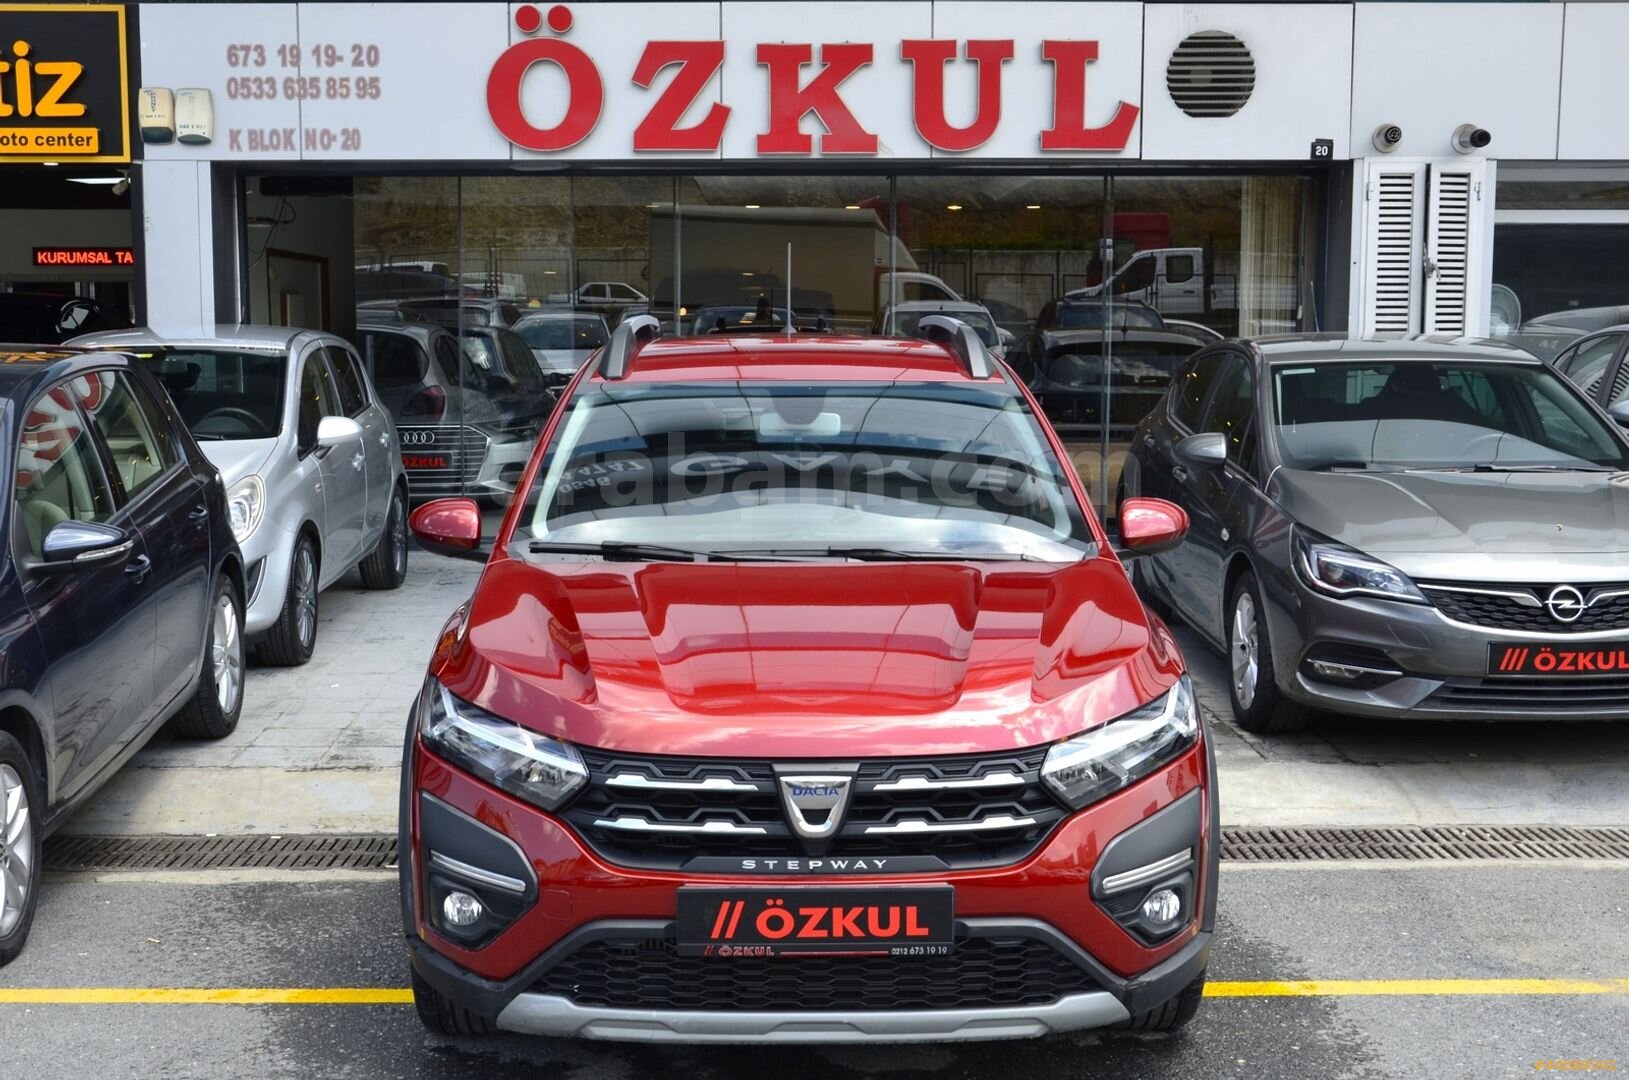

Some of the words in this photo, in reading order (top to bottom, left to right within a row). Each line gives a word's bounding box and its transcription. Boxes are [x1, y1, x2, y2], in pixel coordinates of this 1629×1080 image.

[227, 44, 266, 67] 673
[277, 44, 300, 67] 19
[351, 44, 380, 67] 20
[227, 76, 277, 100] 0533
[283, 76, 321, 100] 635
[326, 76, 350, 100] 85
[355, 76, 381, 100] 95
[487, 5, 1140, 154] ÖZKUL
[0, 133, 28, 146] oto
[35, 133, 93, 146] center
[229, 128, 242, 152] K
[248, 128, 296, 152] BLOK
[340, 128, 361, 151] 20
[1315, 145, 1329, 156] 20
[37, 251, 112, 264] KURUMSAL
[115, 251, 134, 264] TA
[1534, 648, 1629, 671] ÖZKUL
[792, 786, 839, 796] DACIA
[742, 860, 887, 870] STEPWAY
[756, 899, 929, 938] ÖZKUL
[718, 945, 775, 956] ÖZKUL
[892, 947, 908, 955] 0212
[909, 946, 924, 955] 673
[927, 946, 936, 954] 19
[939, 946, 948, 954] 19
